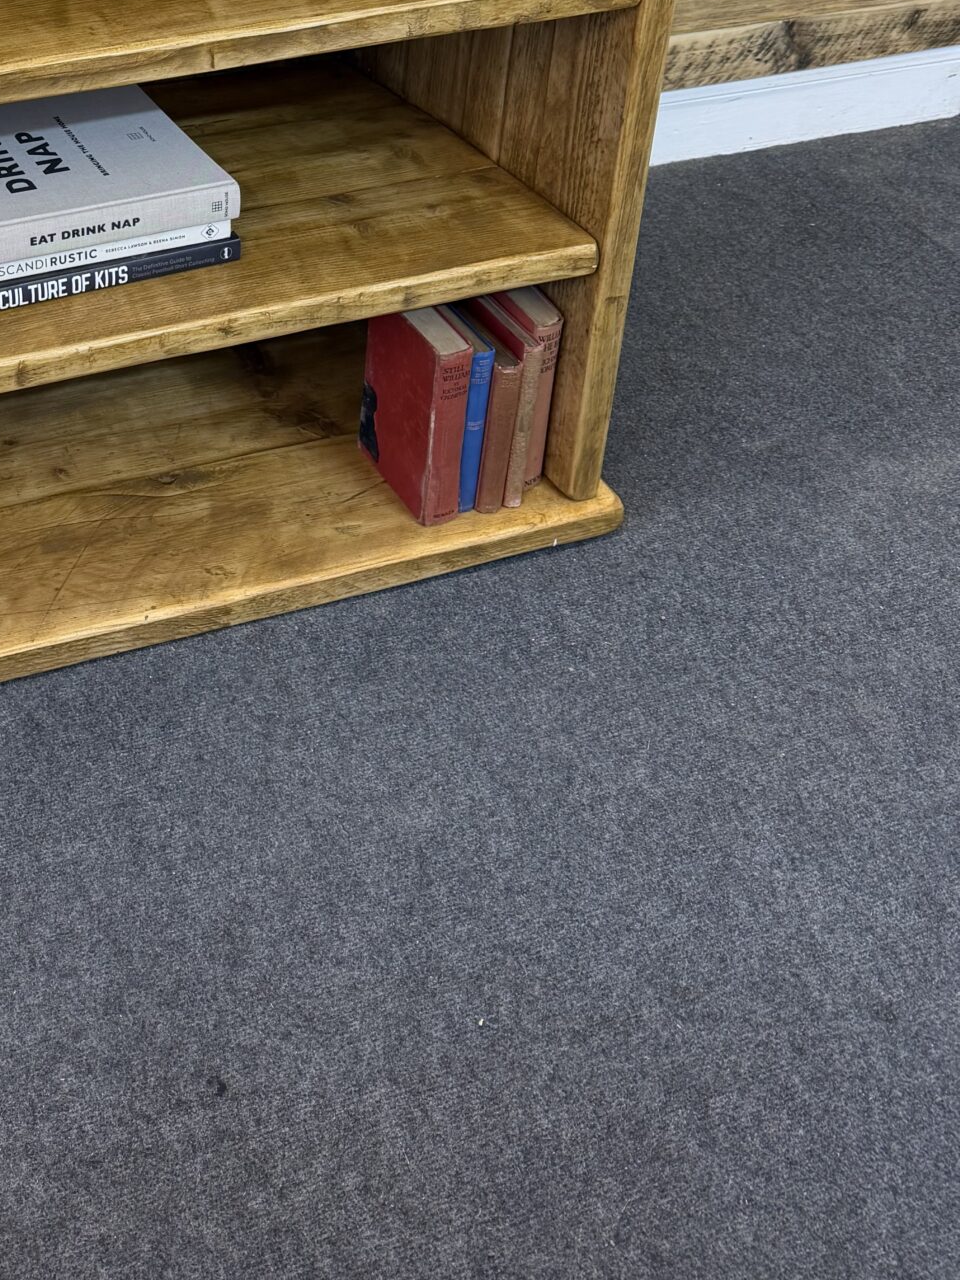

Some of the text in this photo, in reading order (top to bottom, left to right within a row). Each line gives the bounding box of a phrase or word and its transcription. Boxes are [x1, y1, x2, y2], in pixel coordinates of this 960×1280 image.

[64, 129, 81, 145] HOUSE
[14, 132, 71, 175] NAP
[77, 143, 88, 154] THE
[86, 153, 110, 176] BRINGING
[30, 217, 141, 246] EAT DRINK NAP
[128, 241, 148, 250] LAWSON
[71, 273, 91, 294] OF
[94, 265, 129, 290] KITS
[442, 364, 465, 375] STILL
